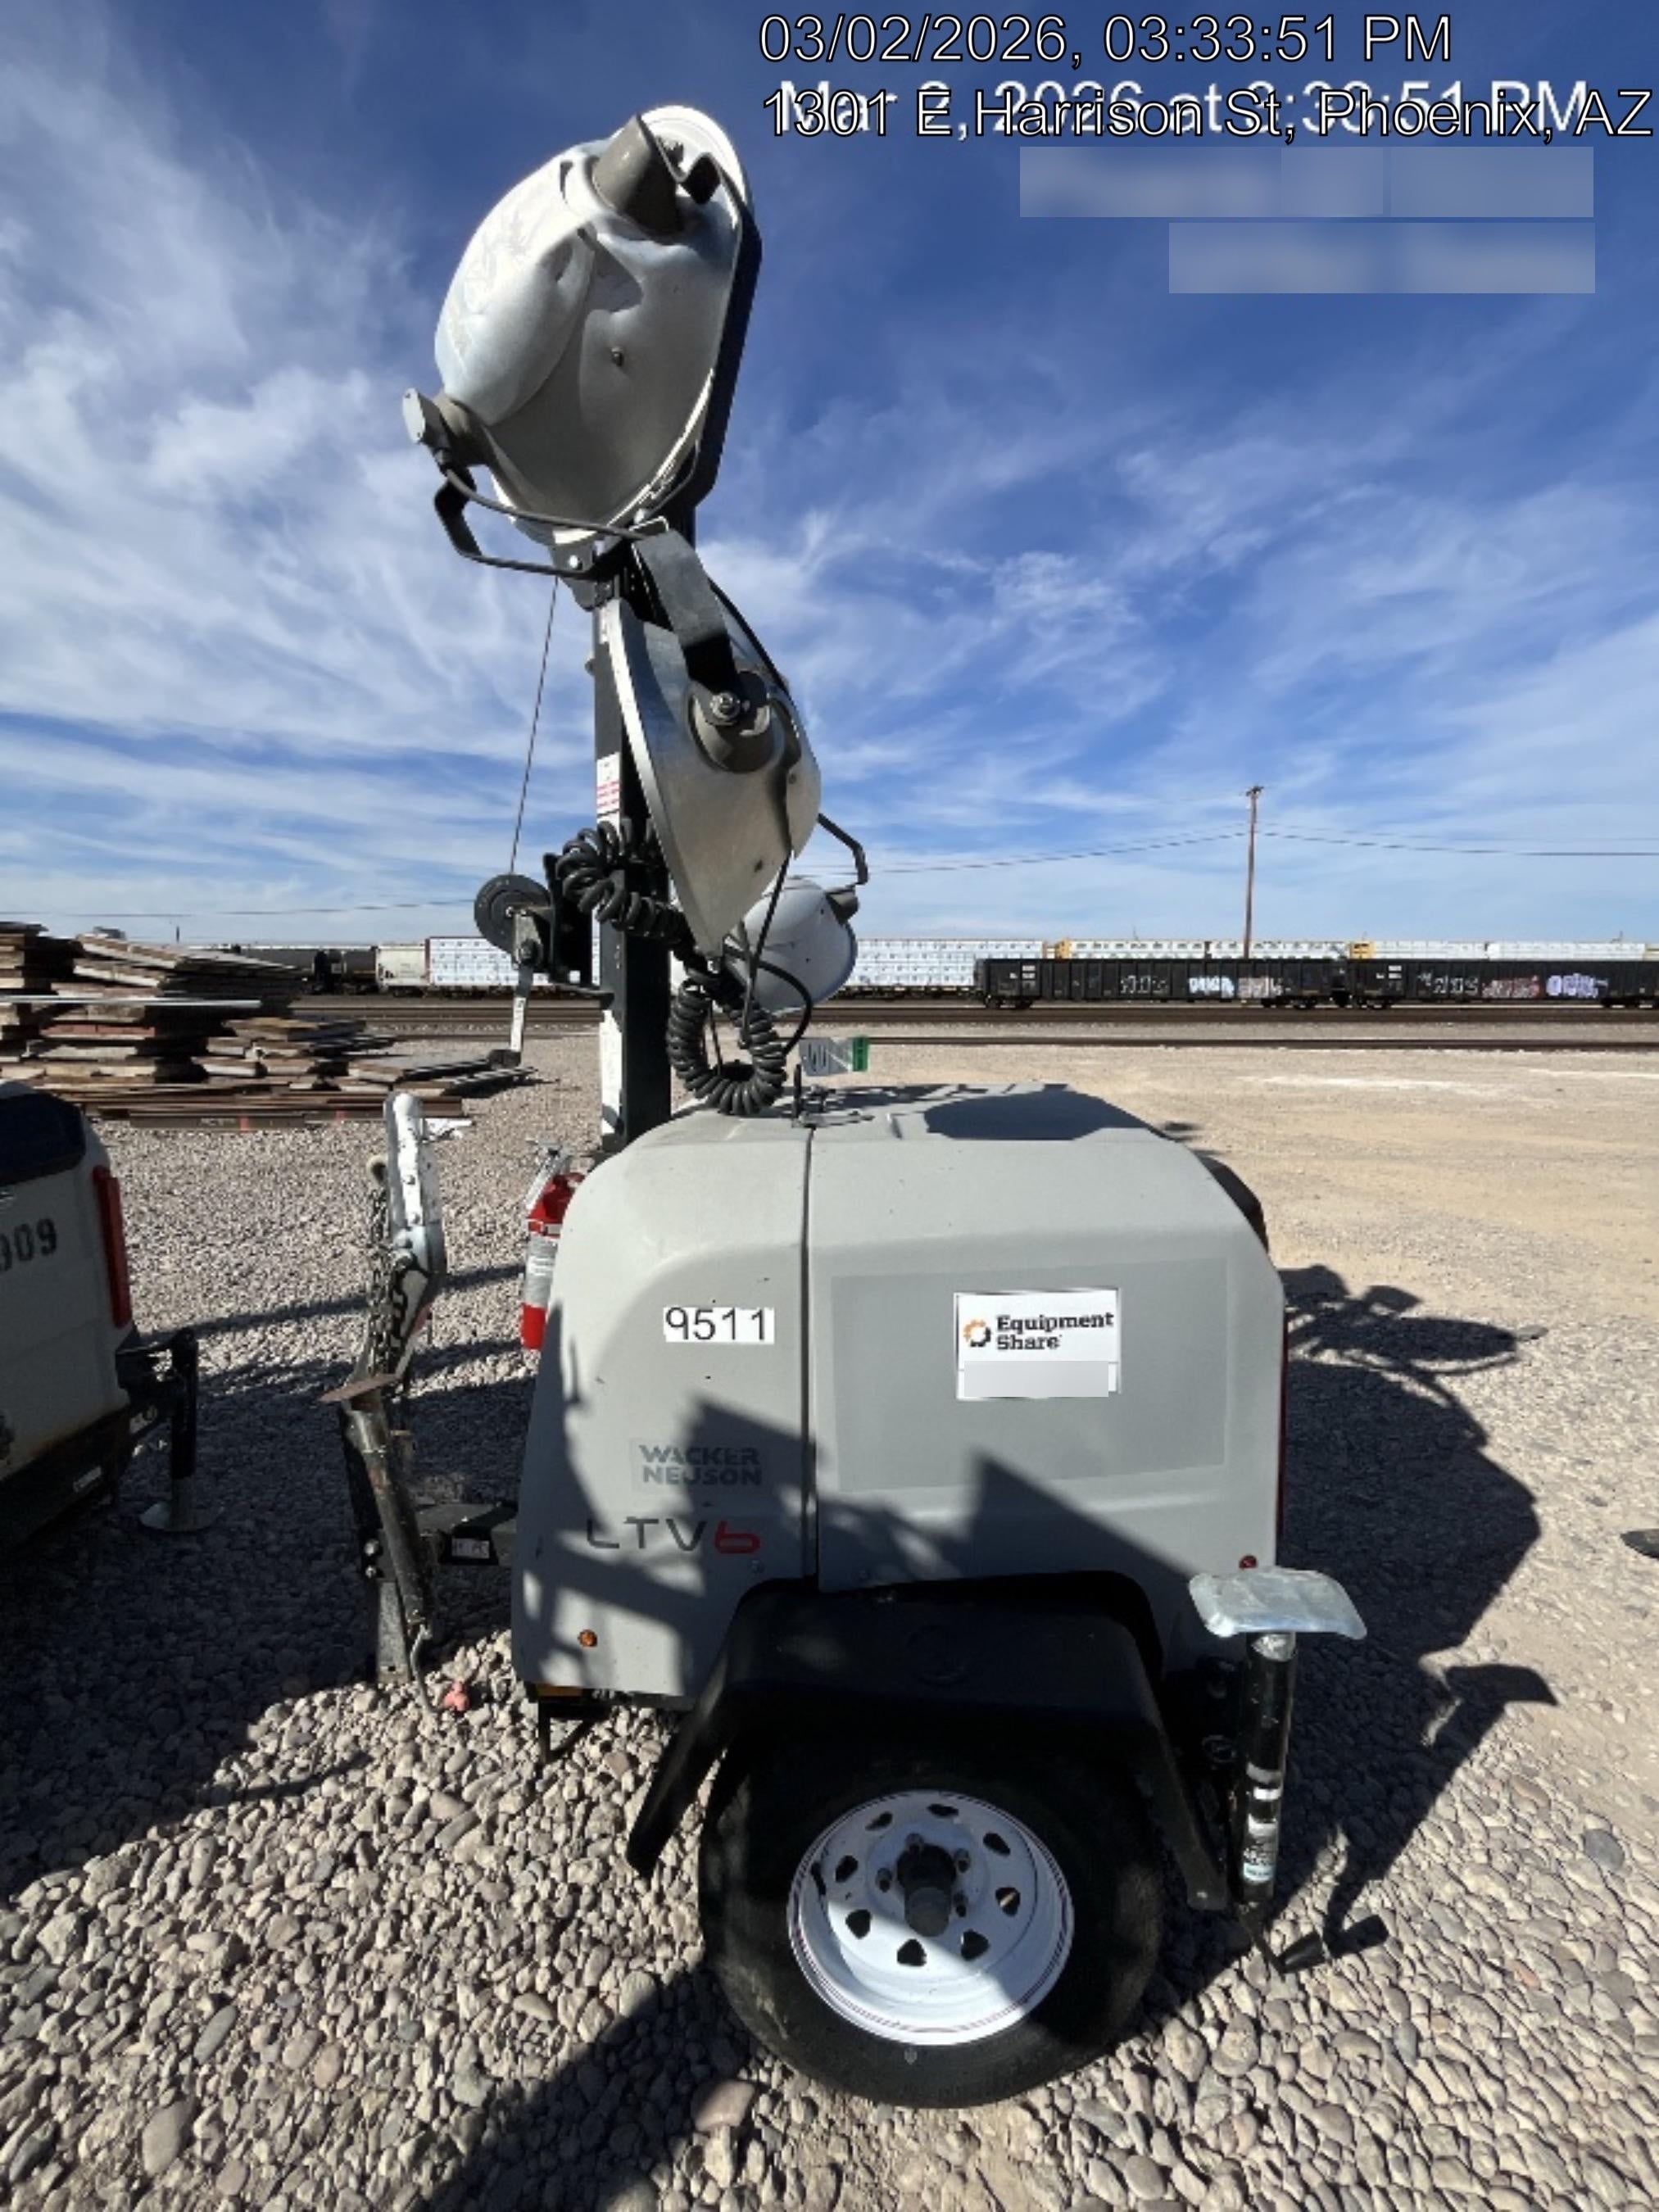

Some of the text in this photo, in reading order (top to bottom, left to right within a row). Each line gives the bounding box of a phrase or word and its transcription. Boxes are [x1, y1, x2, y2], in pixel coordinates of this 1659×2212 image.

[665, 1306, 765, 1340] 9511
[996, 1312, 1114, 1335] Equipment
[996, 1334, 1060, 1351] Share
[639, 1444, 760, 1466] WACKER
